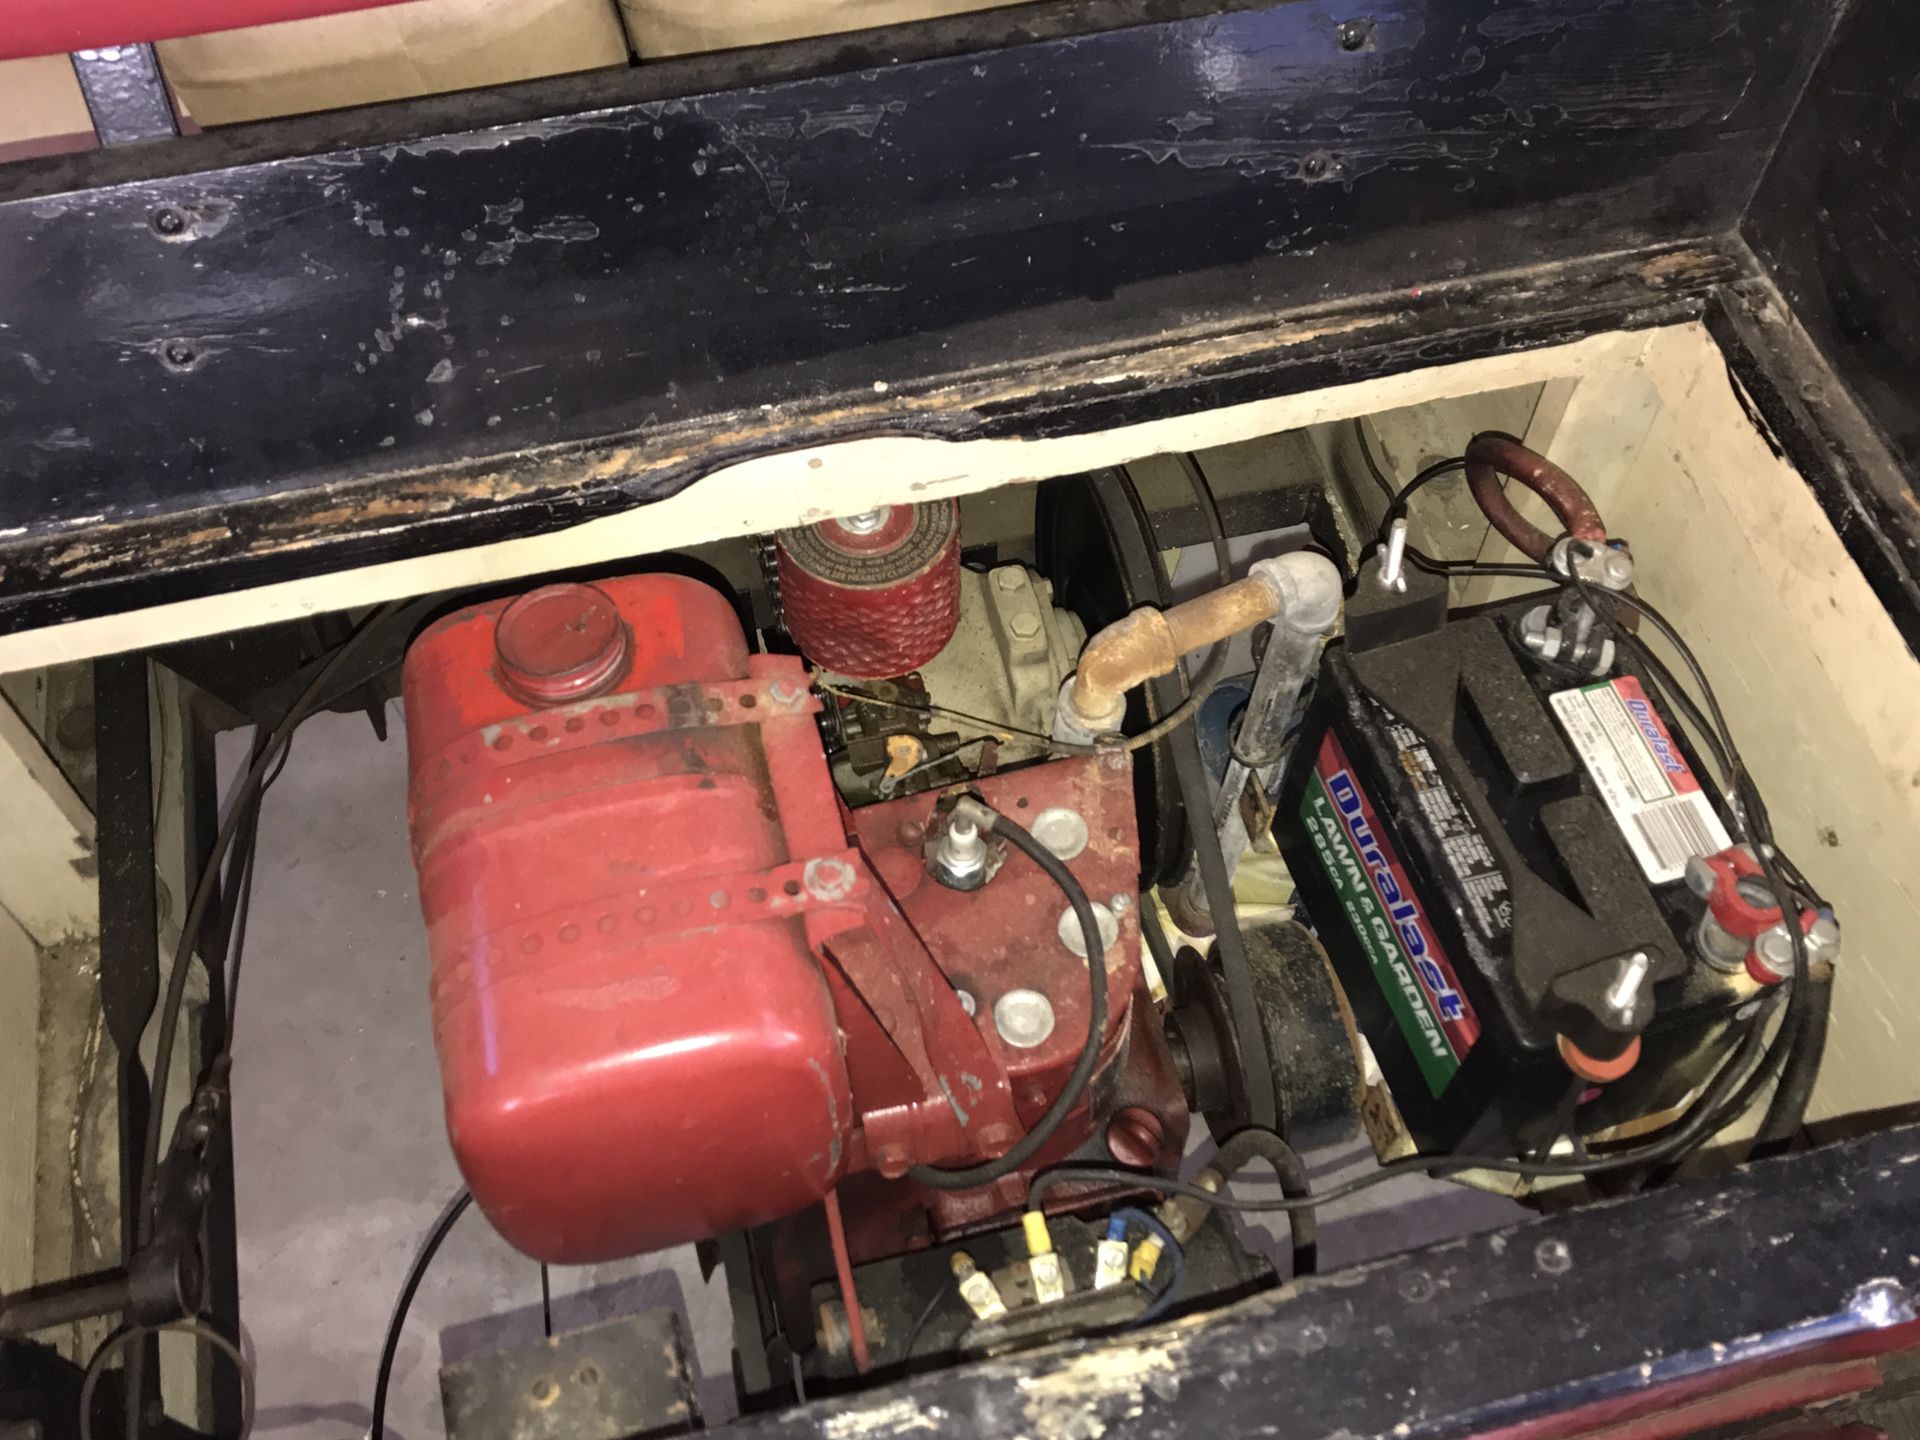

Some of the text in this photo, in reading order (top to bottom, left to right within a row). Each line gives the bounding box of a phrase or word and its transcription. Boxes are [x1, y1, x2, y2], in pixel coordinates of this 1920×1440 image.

[1626, 699, 1685, 773] Duralast
[1312, 797, 1448, 1058] LAWN & GARDEN
[1327, 769, 1466, 1021] Duralast
